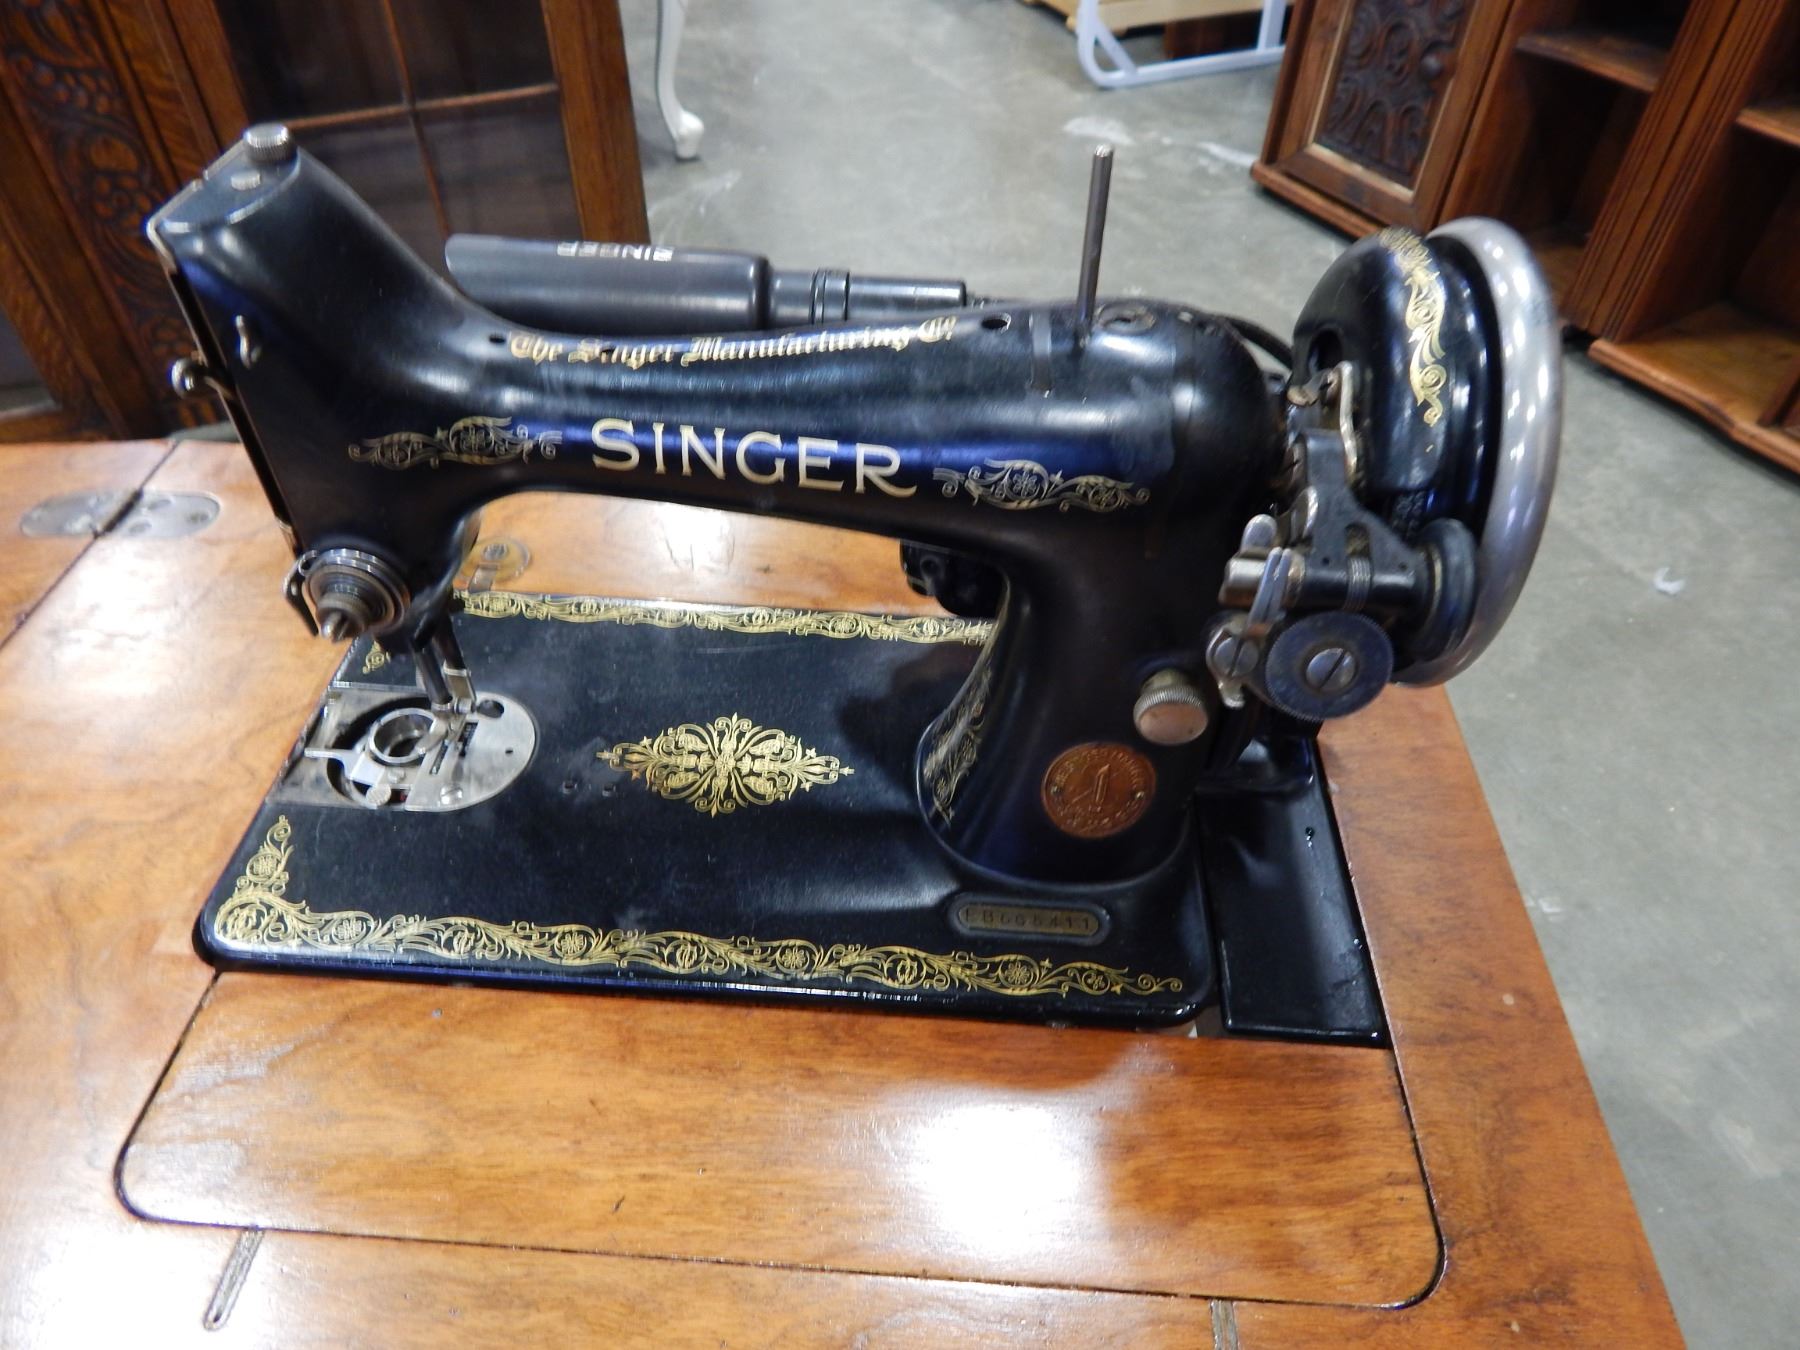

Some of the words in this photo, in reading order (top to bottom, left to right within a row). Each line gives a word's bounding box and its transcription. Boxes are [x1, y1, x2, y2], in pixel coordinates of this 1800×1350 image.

[509, 331, 563, 365] The
[568, 337, 674, 370] Singer
[680, 326, 911, 368] Manufacturing
[591, 417, 918, 499] SINGER
